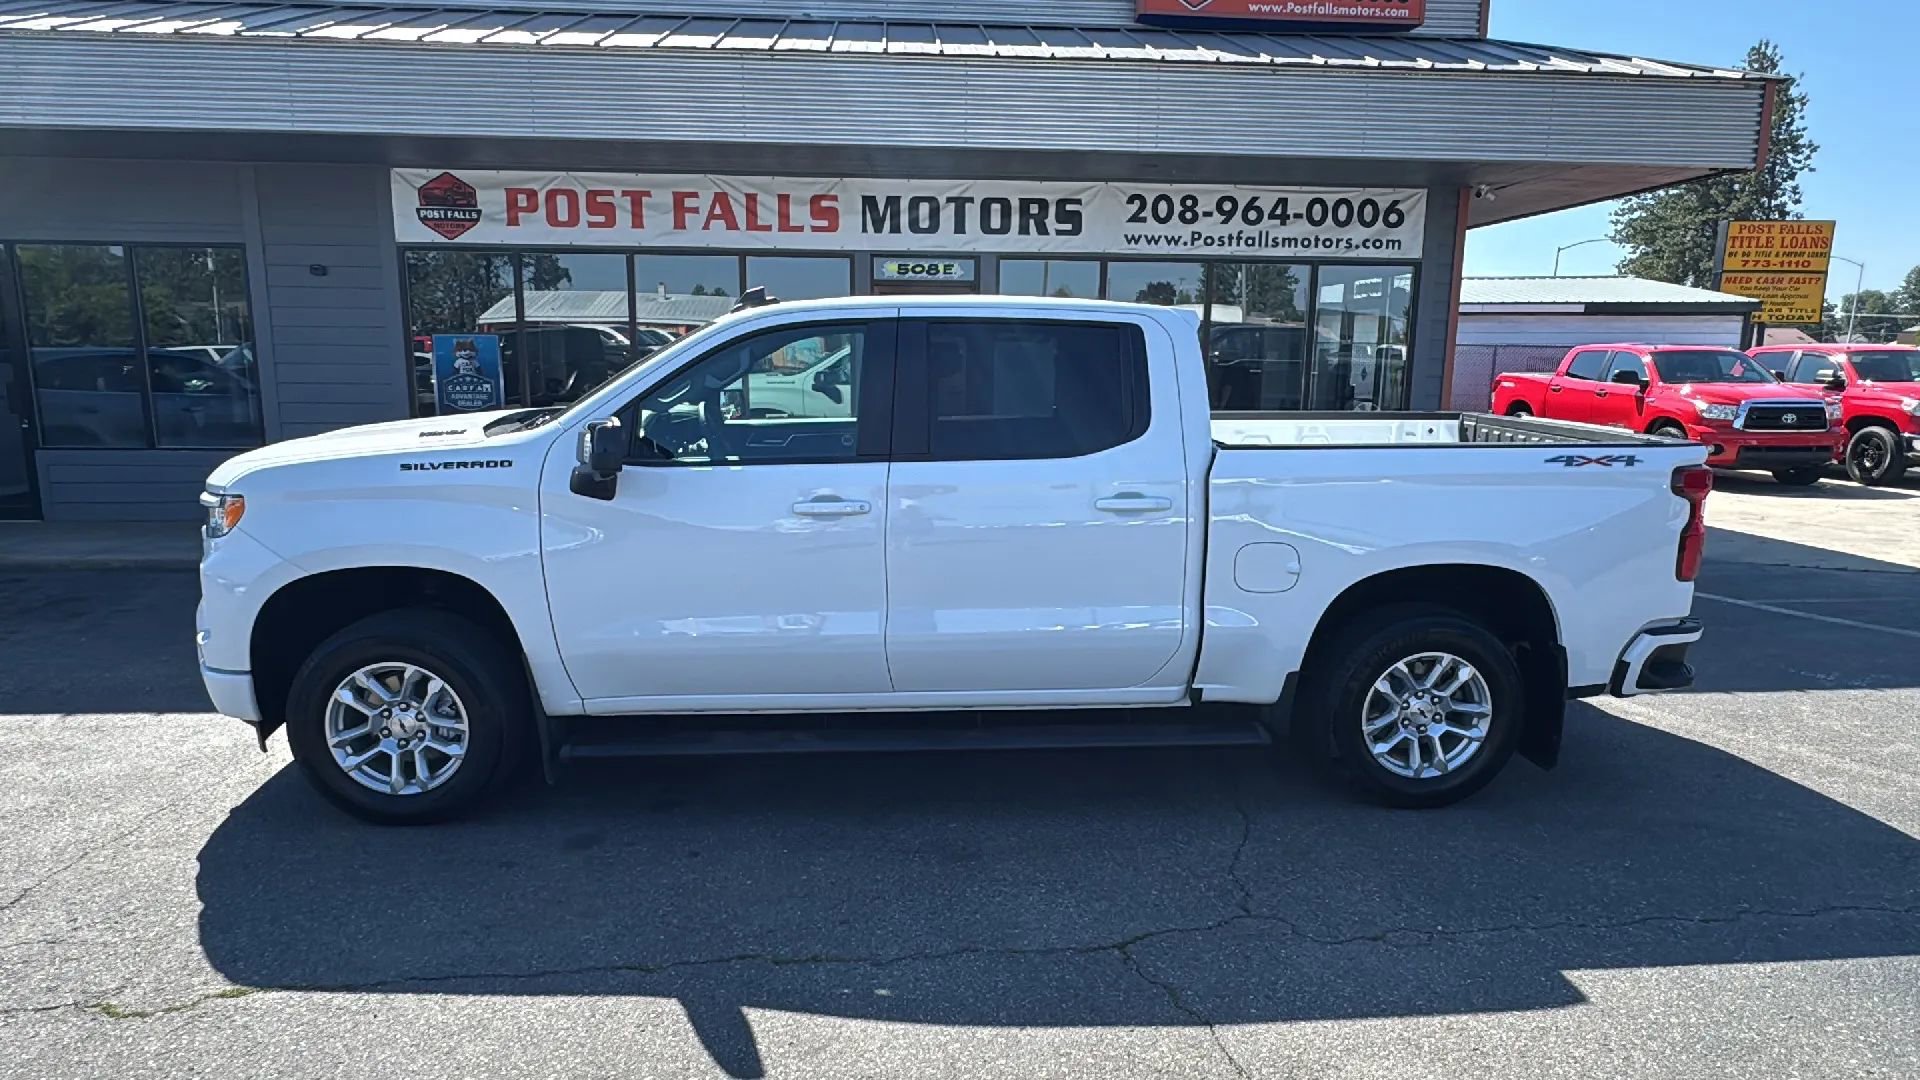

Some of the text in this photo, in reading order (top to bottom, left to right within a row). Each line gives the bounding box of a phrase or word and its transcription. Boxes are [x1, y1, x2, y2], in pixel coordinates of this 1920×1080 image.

[1248, 2, 1409, 17] www.Postfallsmotors.com
[420, 209, 478, 219] POST FALLS
[504, 187, 1083, 237] POST FALLS MOTORS
[1125, 194, 1406, 229] 208-964-0006
[1738, 224, 1823, 234] POST FALLS
[1124, 230, 1402, 250] www.Postfallsmotors.com
[1729, 235, 1829, 250] TITLE LOANS
[897, 264, 940, 276] 508
[1740, 260, 1812, 268] 773-1110
[1724, 276, 1821, 285] NEED CASH FAST?
[400, 460, 512, 471] SILVERADO
